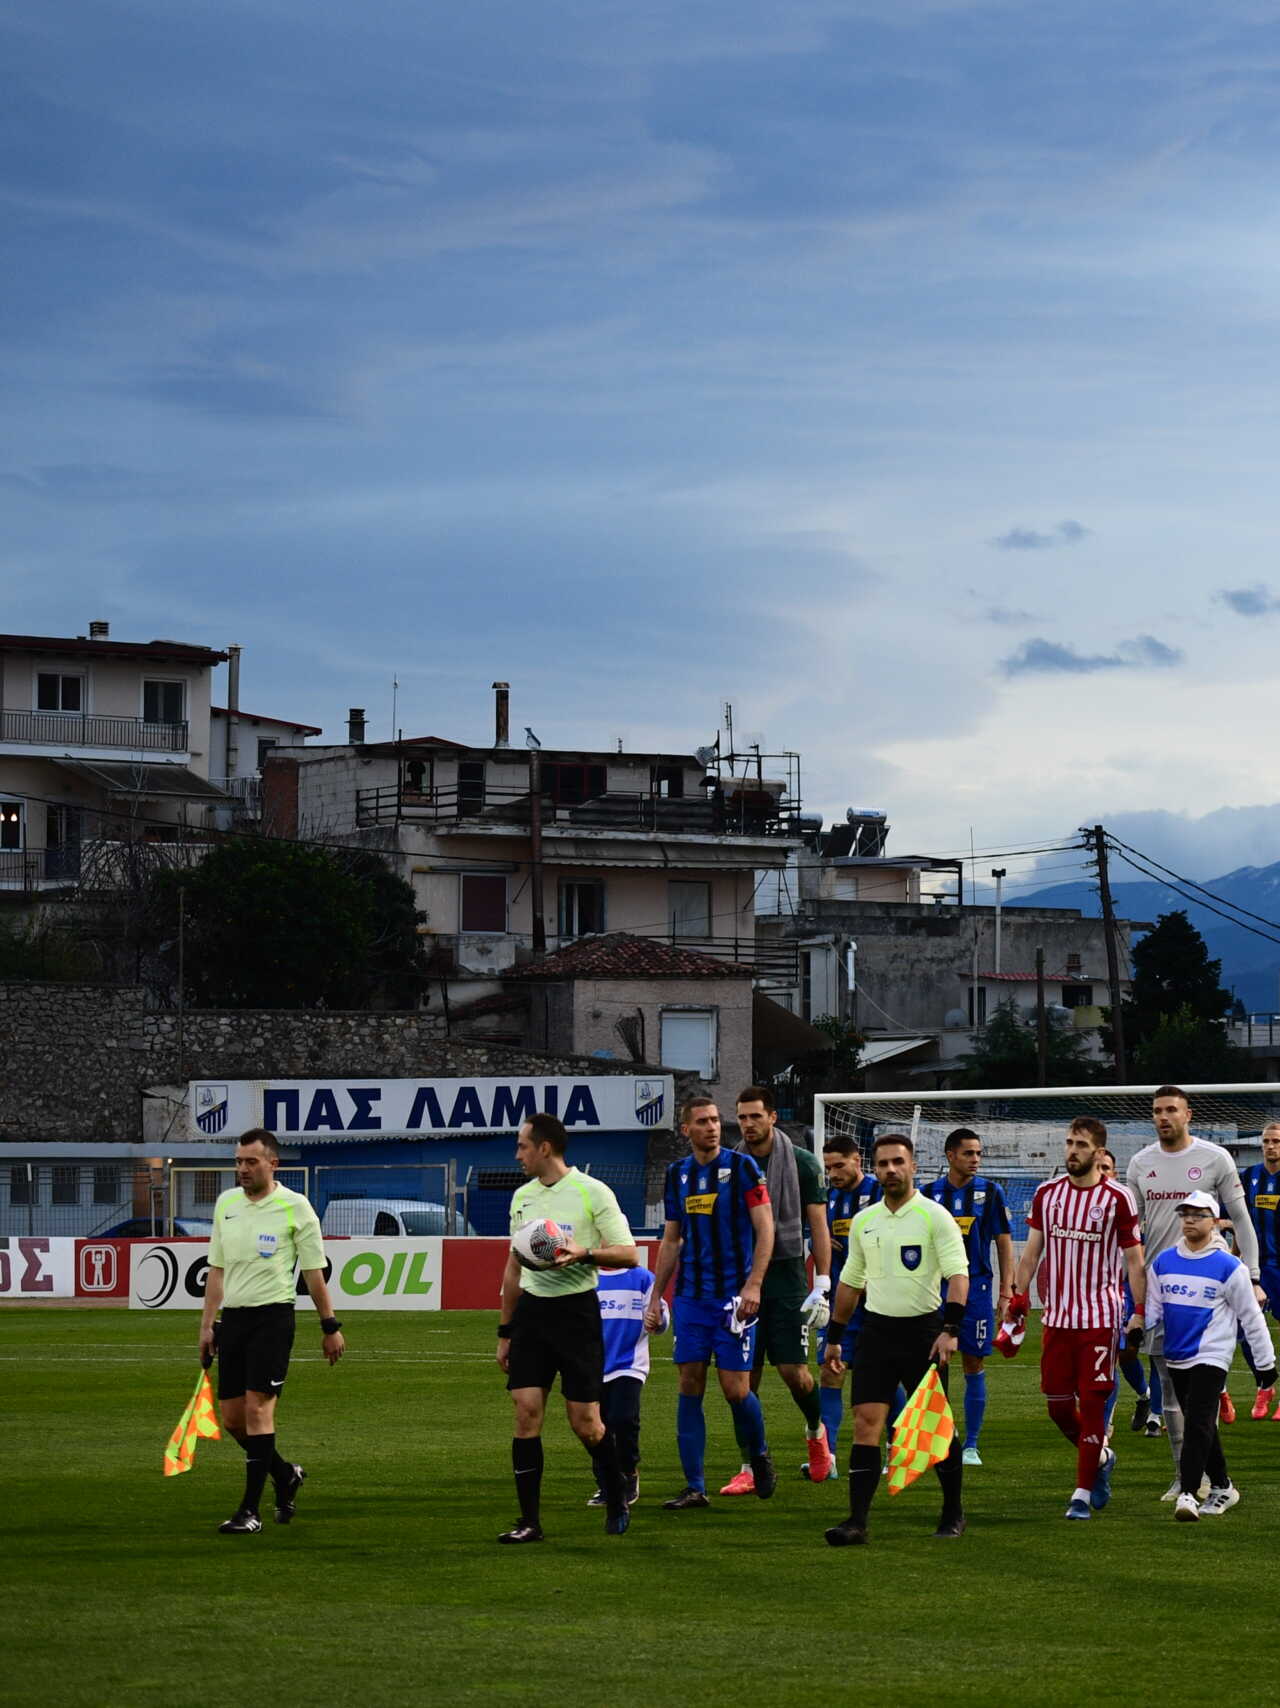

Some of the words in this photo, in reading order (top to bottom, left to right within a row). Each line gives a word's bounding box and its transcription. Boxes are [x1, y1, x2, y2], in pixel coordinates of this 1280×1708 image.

[263, 1087, 382, 1131] ΠΑΣ
[405, 1084, 601, 1129] ΛΑΜΙΑ
[259, 1234, 276, 1242] FIFA
[1050, 1223, 1102, 1242] Stoiximan
[340, 1252, 433, 1296] OIL
[975, 1319, 987, 1339] 15
[1093, 1346, 1109, 1371] 7
